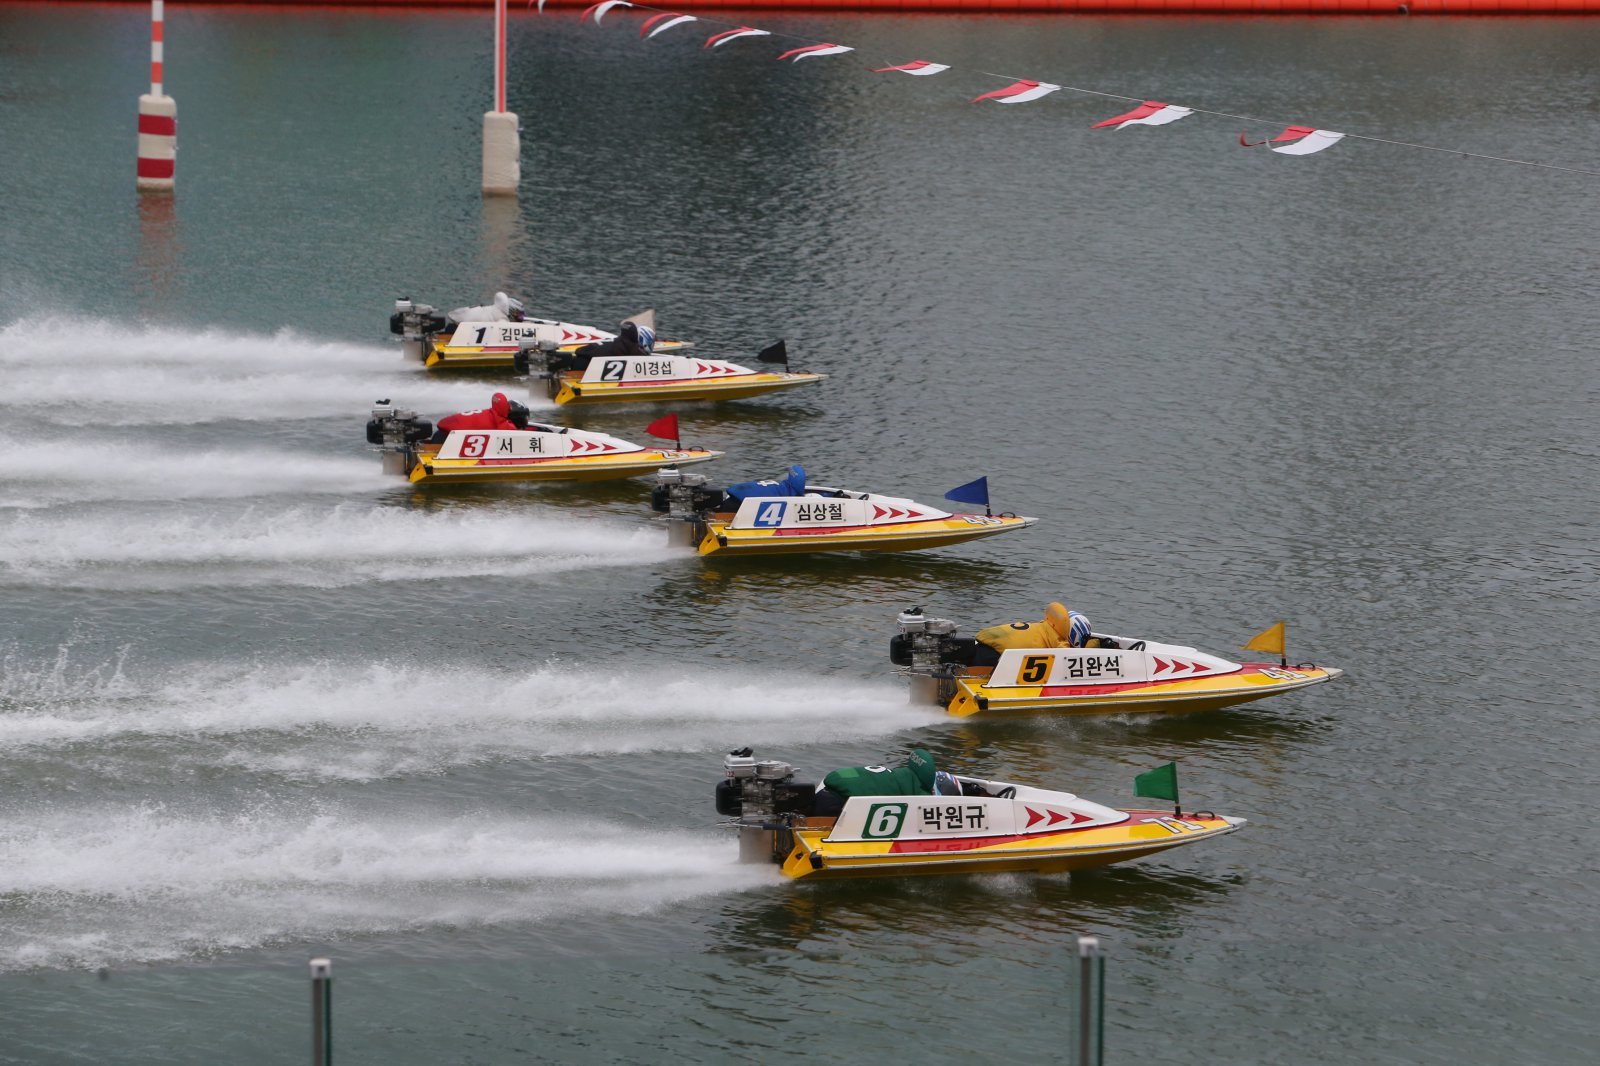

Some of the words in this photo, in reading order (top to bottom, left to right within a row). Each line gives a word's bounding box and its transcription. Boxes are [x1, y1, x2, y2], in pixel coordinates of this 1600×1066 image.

[475, 327, 487, 344] 1
[603, 361, 624, 380] 2
[635, 361, 672, 376] 이경섭
[463, 435, 486, 457] 3
[759, 503, 782, 525] 4
[798, 503, 842, 521] 심상철
[1023, 656, 1049, 682] 5
[1067, 656, 1120, 678] 김완석
[869, 805, 902, 837] 6
[923, 805, 985, 830] 박원규
[1139, 816, 1206, 834] 71
